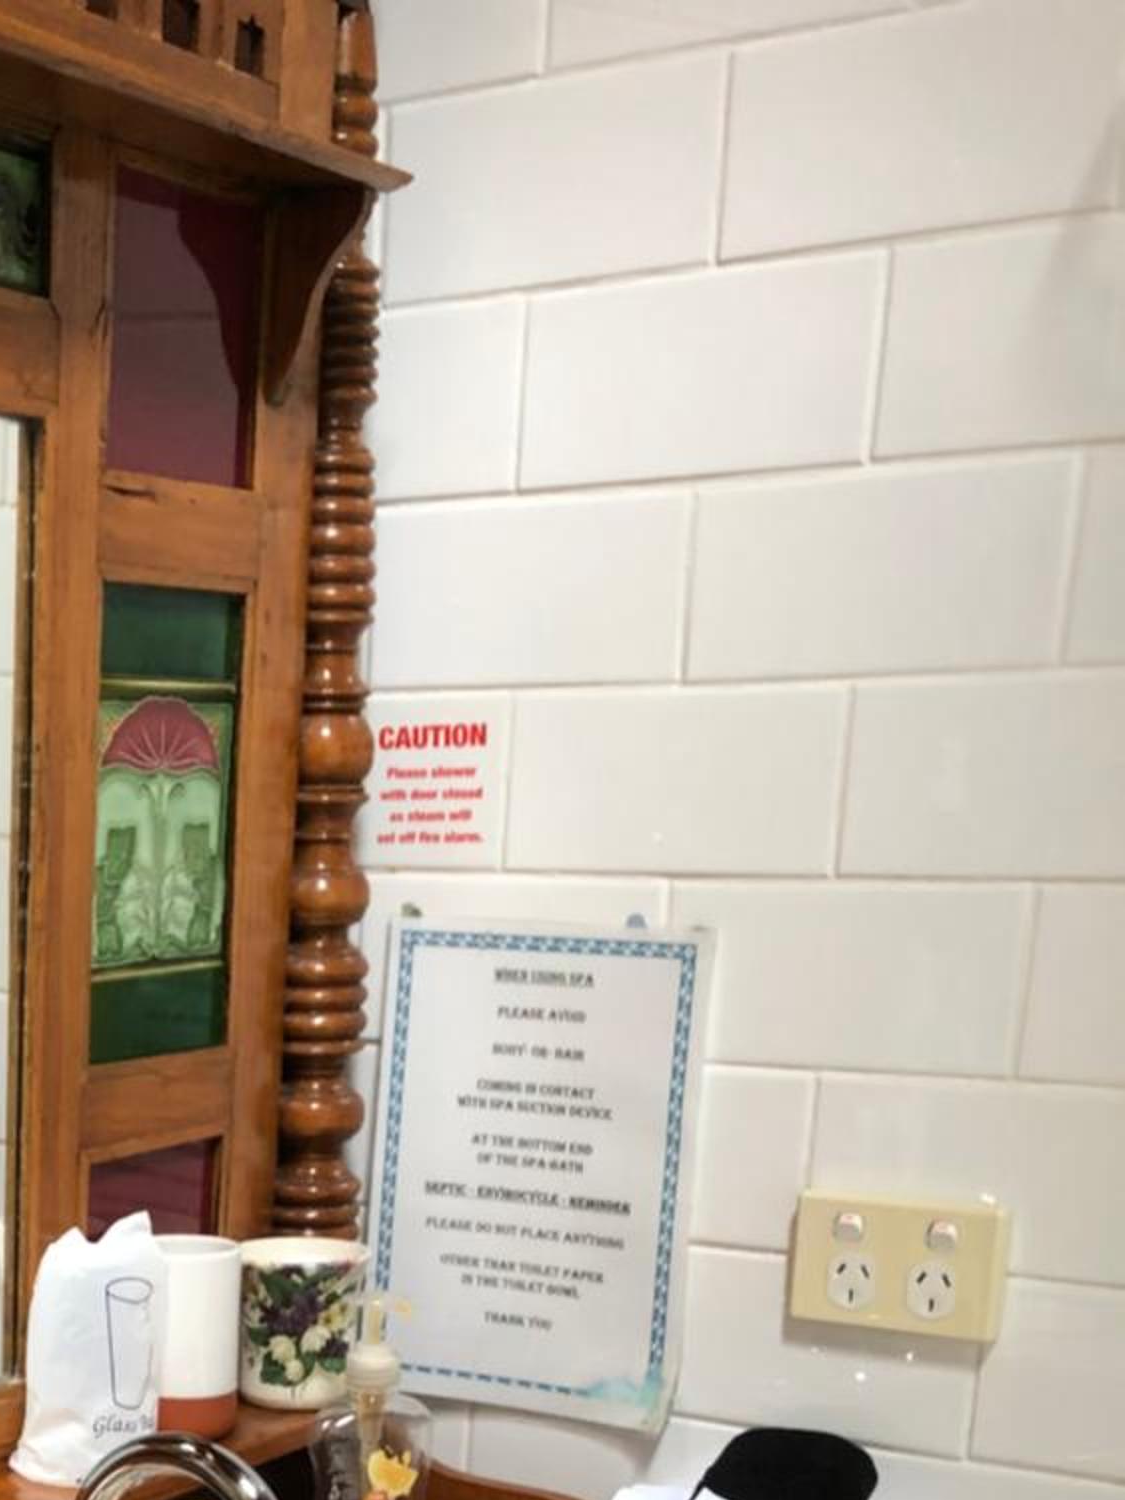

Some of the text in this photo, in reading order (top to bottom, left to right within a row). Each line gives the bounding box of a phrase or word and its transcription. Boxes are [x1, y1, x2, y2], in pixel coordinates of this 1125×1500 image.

[378, 721, 488, 750] CAUTION
[386, 765, 476, 779] Please shower
[379, 785, 483, 801] with door closed
[408, 810, 445, 822] steam
[449, 809, 472, 821] will
[399, 831, 416, 843] off
[419, 831, 440, 843] fire
[494, 969, 594, 988] WHEN USING SPA
[497, 1005, 587, 1023] PLEASE AVOID
[492, 1043, 526, 1056] BODY
[554, 1048, 585, 1061] HAIR
[476, 1078, 595, 1101] COMING IN CONTACT
[457, 1095, 486, 1108] WITH
[489, 1099, 514, 1112] SPA
[517, 1101, 566, 1116] SUCTION
[472, 1133, 594, 1156] AT THE BOTTOM END
[476, 1152, 584, 1174] OF THE SPA BATH
[425, 1180, 631, 1217] SEPTIC ENVIROCYCLE REMINDER
[426, 1216, 624, 1250] PLEASE DO NOT PLACE ANYTHING
[439, 1253, 605, 1284] OTHER THAN TOILET PAPER
[476, 1275, 499, 1288] THE
[501, 1277, 544, 1294] TOILET
[484, 1311, 553, 1331] THANK YOU
